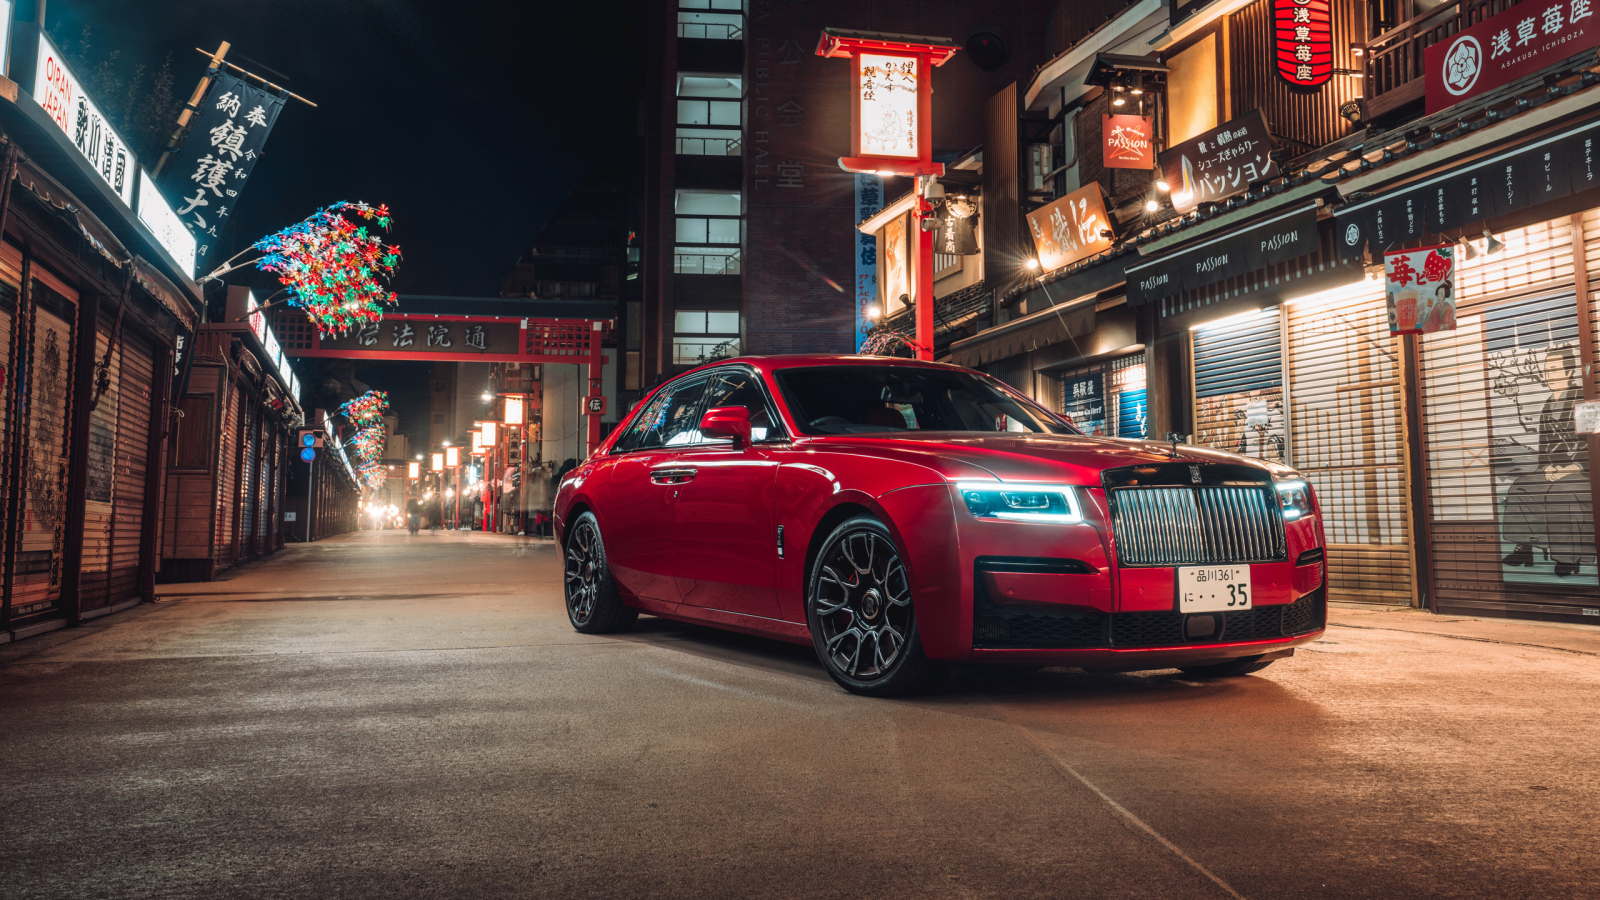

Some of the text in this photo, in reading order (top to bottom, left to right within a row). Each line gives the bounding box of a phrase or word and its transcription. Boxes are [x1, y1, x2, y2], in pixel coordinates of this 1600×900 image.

[1293, 7, 1313, 81] 浅草苺座
[1490, 0, 1594, 60] 浅草苺座
[1501, 29, 1585, 70] ASAKUSA ICHIGOZA
[46, 56, 72, 106] OIRAN
[755, 37, 770, 118] PUBLIC
[42, 85, 69, 135] JAPAN
[754, 131, 769, 190] HALL
[1108, 138, 1148, 149] PASSION
[177, 119, 248, 235] 鎮護大
[1196, 252, 1229, 274] PASSION
[1261, 230, 1298, 252] PASSION
[1140, 272, 1169, 291] PASSION
[356, 322, 487, 350] 伝法院通
[589, 399, 602, 411] 伝
